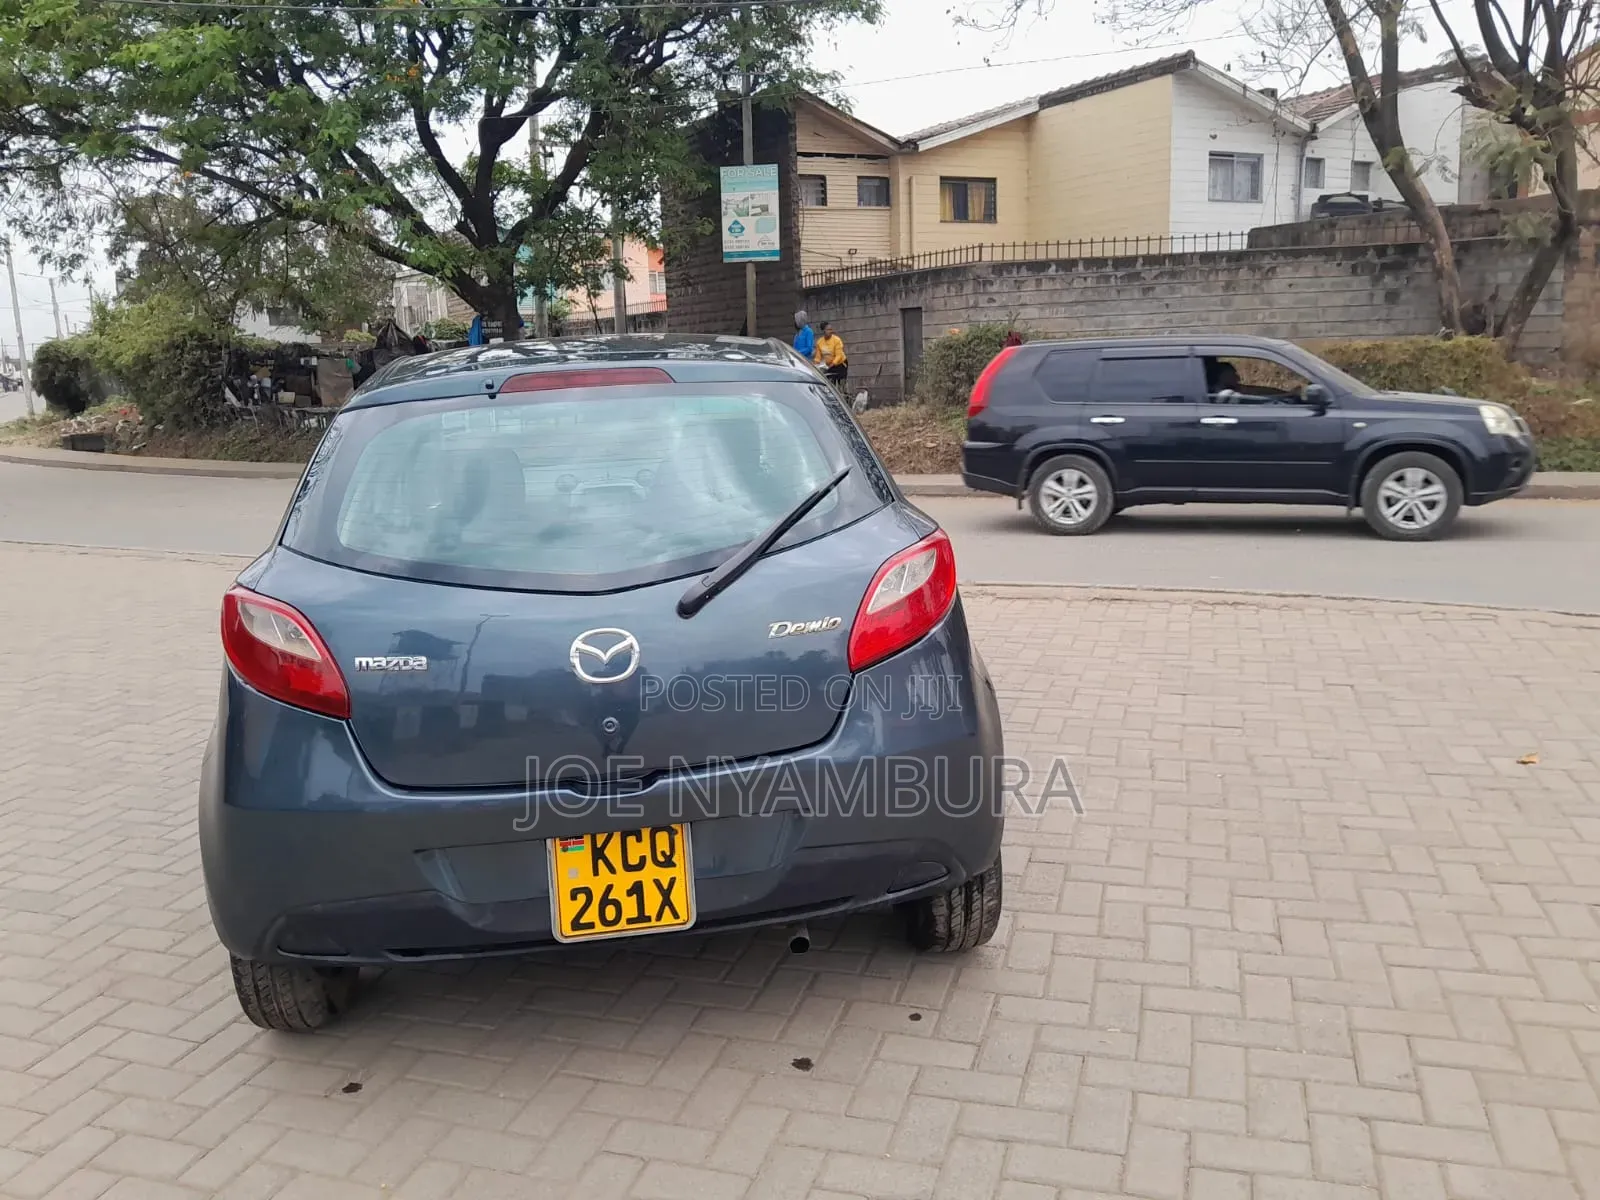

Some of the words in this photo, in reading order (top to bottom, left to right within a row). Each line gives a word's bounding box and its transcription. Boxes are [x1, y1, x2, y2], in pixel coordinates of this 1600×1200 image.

[721, 167, 745, 178] FOR
[747, 166, 777, 177] SALE
[768, 616, 842, 639] Demio
[590, 825, 678, 877] KCQ
[570, 876, 681, 931] 261X
